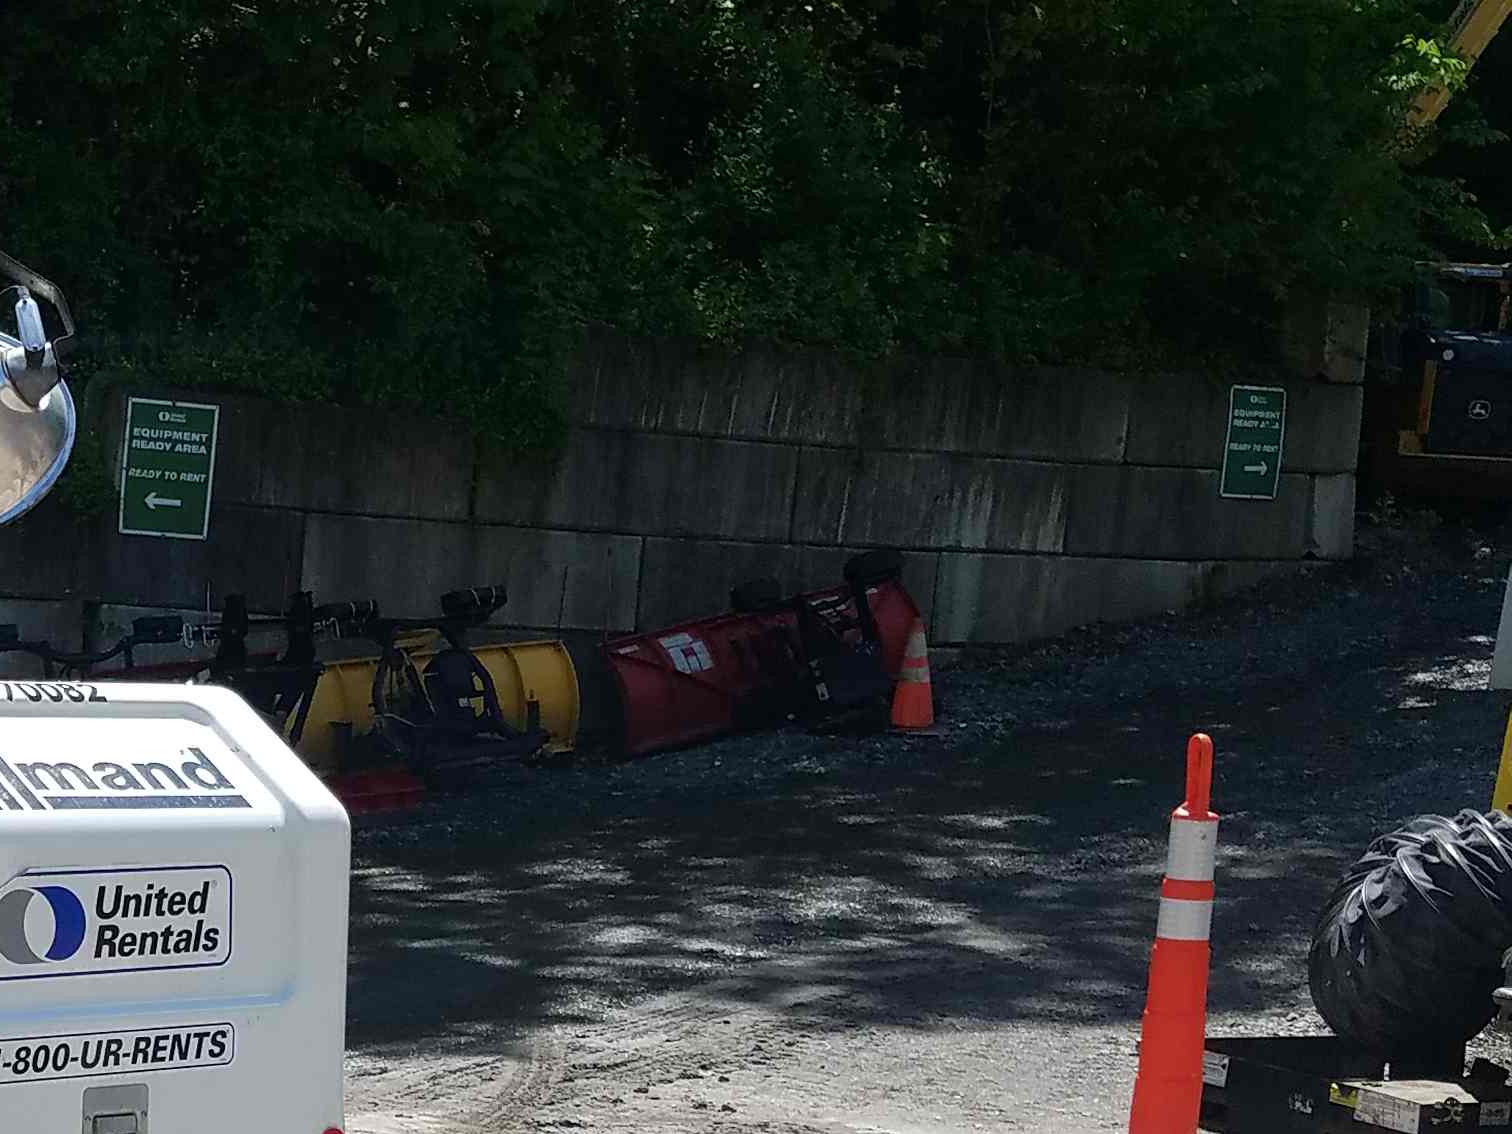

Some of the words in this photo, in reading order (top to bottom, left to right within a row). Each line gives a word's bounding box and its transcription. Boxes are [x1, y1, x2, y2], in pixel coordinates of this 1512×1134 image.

[133, 427, 208, 443] EQUIPMENT
[132, 439, 172, 451] READY
[174, 443, 207, 455] AREA
[128, 467, 162, 479] READY
[164, 470, 177, 480] TO
[179, 472, 207, 483] RENT
[95, 881, 210, 920] United
[94, 919, 219, 959] Rentals
